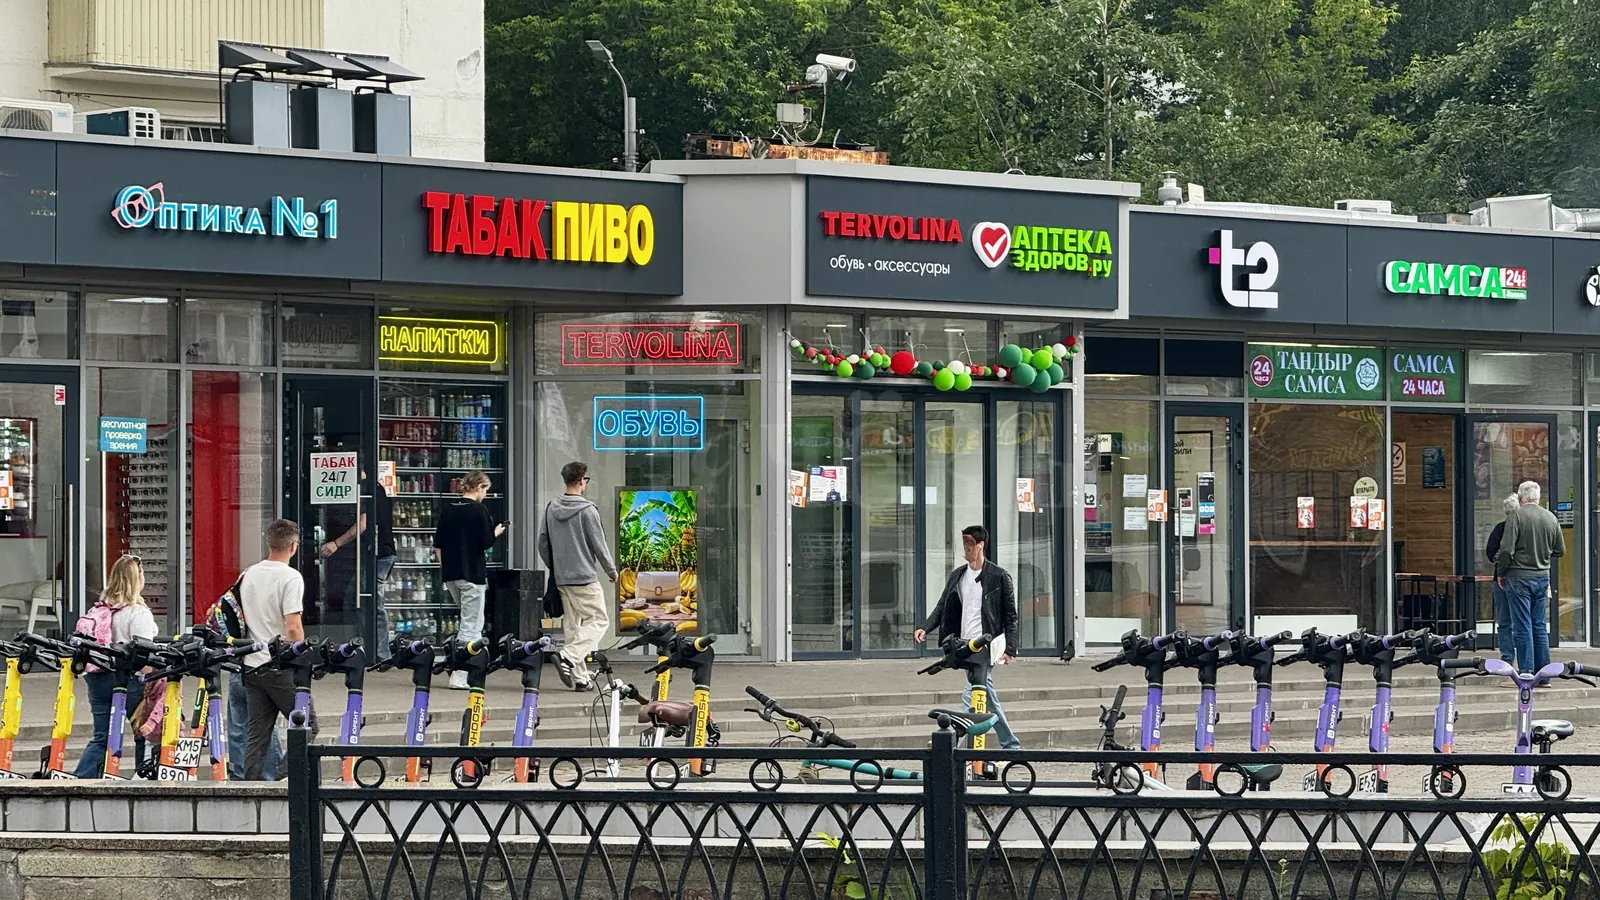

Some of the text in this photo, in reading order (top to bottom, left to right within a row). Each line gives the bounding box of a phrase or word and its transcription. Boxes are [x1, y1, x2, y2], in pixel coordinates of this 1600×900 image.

[271, 195, 338, 239] №1
[820, 211, 963, 243] TERVOLINA
[422, 191, 655, 266] ТАБАК ПИВО
[1013, 225, 1112, 255] АПТЕКА
[830, 254, 950, 277] обувь аксессуары
[1220, 229, 1279, 308] t2
[1386, 260, 1502, 298] САМСА
[1505, 269, 1522, 287] 24
[380, 325, 489, 355] НАПИТКИ
[567, 330, 733, 360] TERVOLINA
[1253, 360, 1271, 375] 24
[1277, 351, 1352, 372] ТАНДЫР
[1393, 354, 1456, 374] САМСА
[1285, 374, 1346, 394] САМСА
[1402, 378, 1445, 396] 24 ЧАСА
[101, 420, 147, 430] бесплатная
[598, 408, 699, 438] ОБУВЬ
[105, 431, 142, 441] проверка
[109, 441, 138, 451] зрения
[312, 456, 356, 469] ТАБАК
[321, 471, 347, 484] 24/7
[315, 485, 352, 499] СИДР
[418, 707, 426, 732] ЮРЕНТ
[694, 693, 708, 747] WHOOSH
